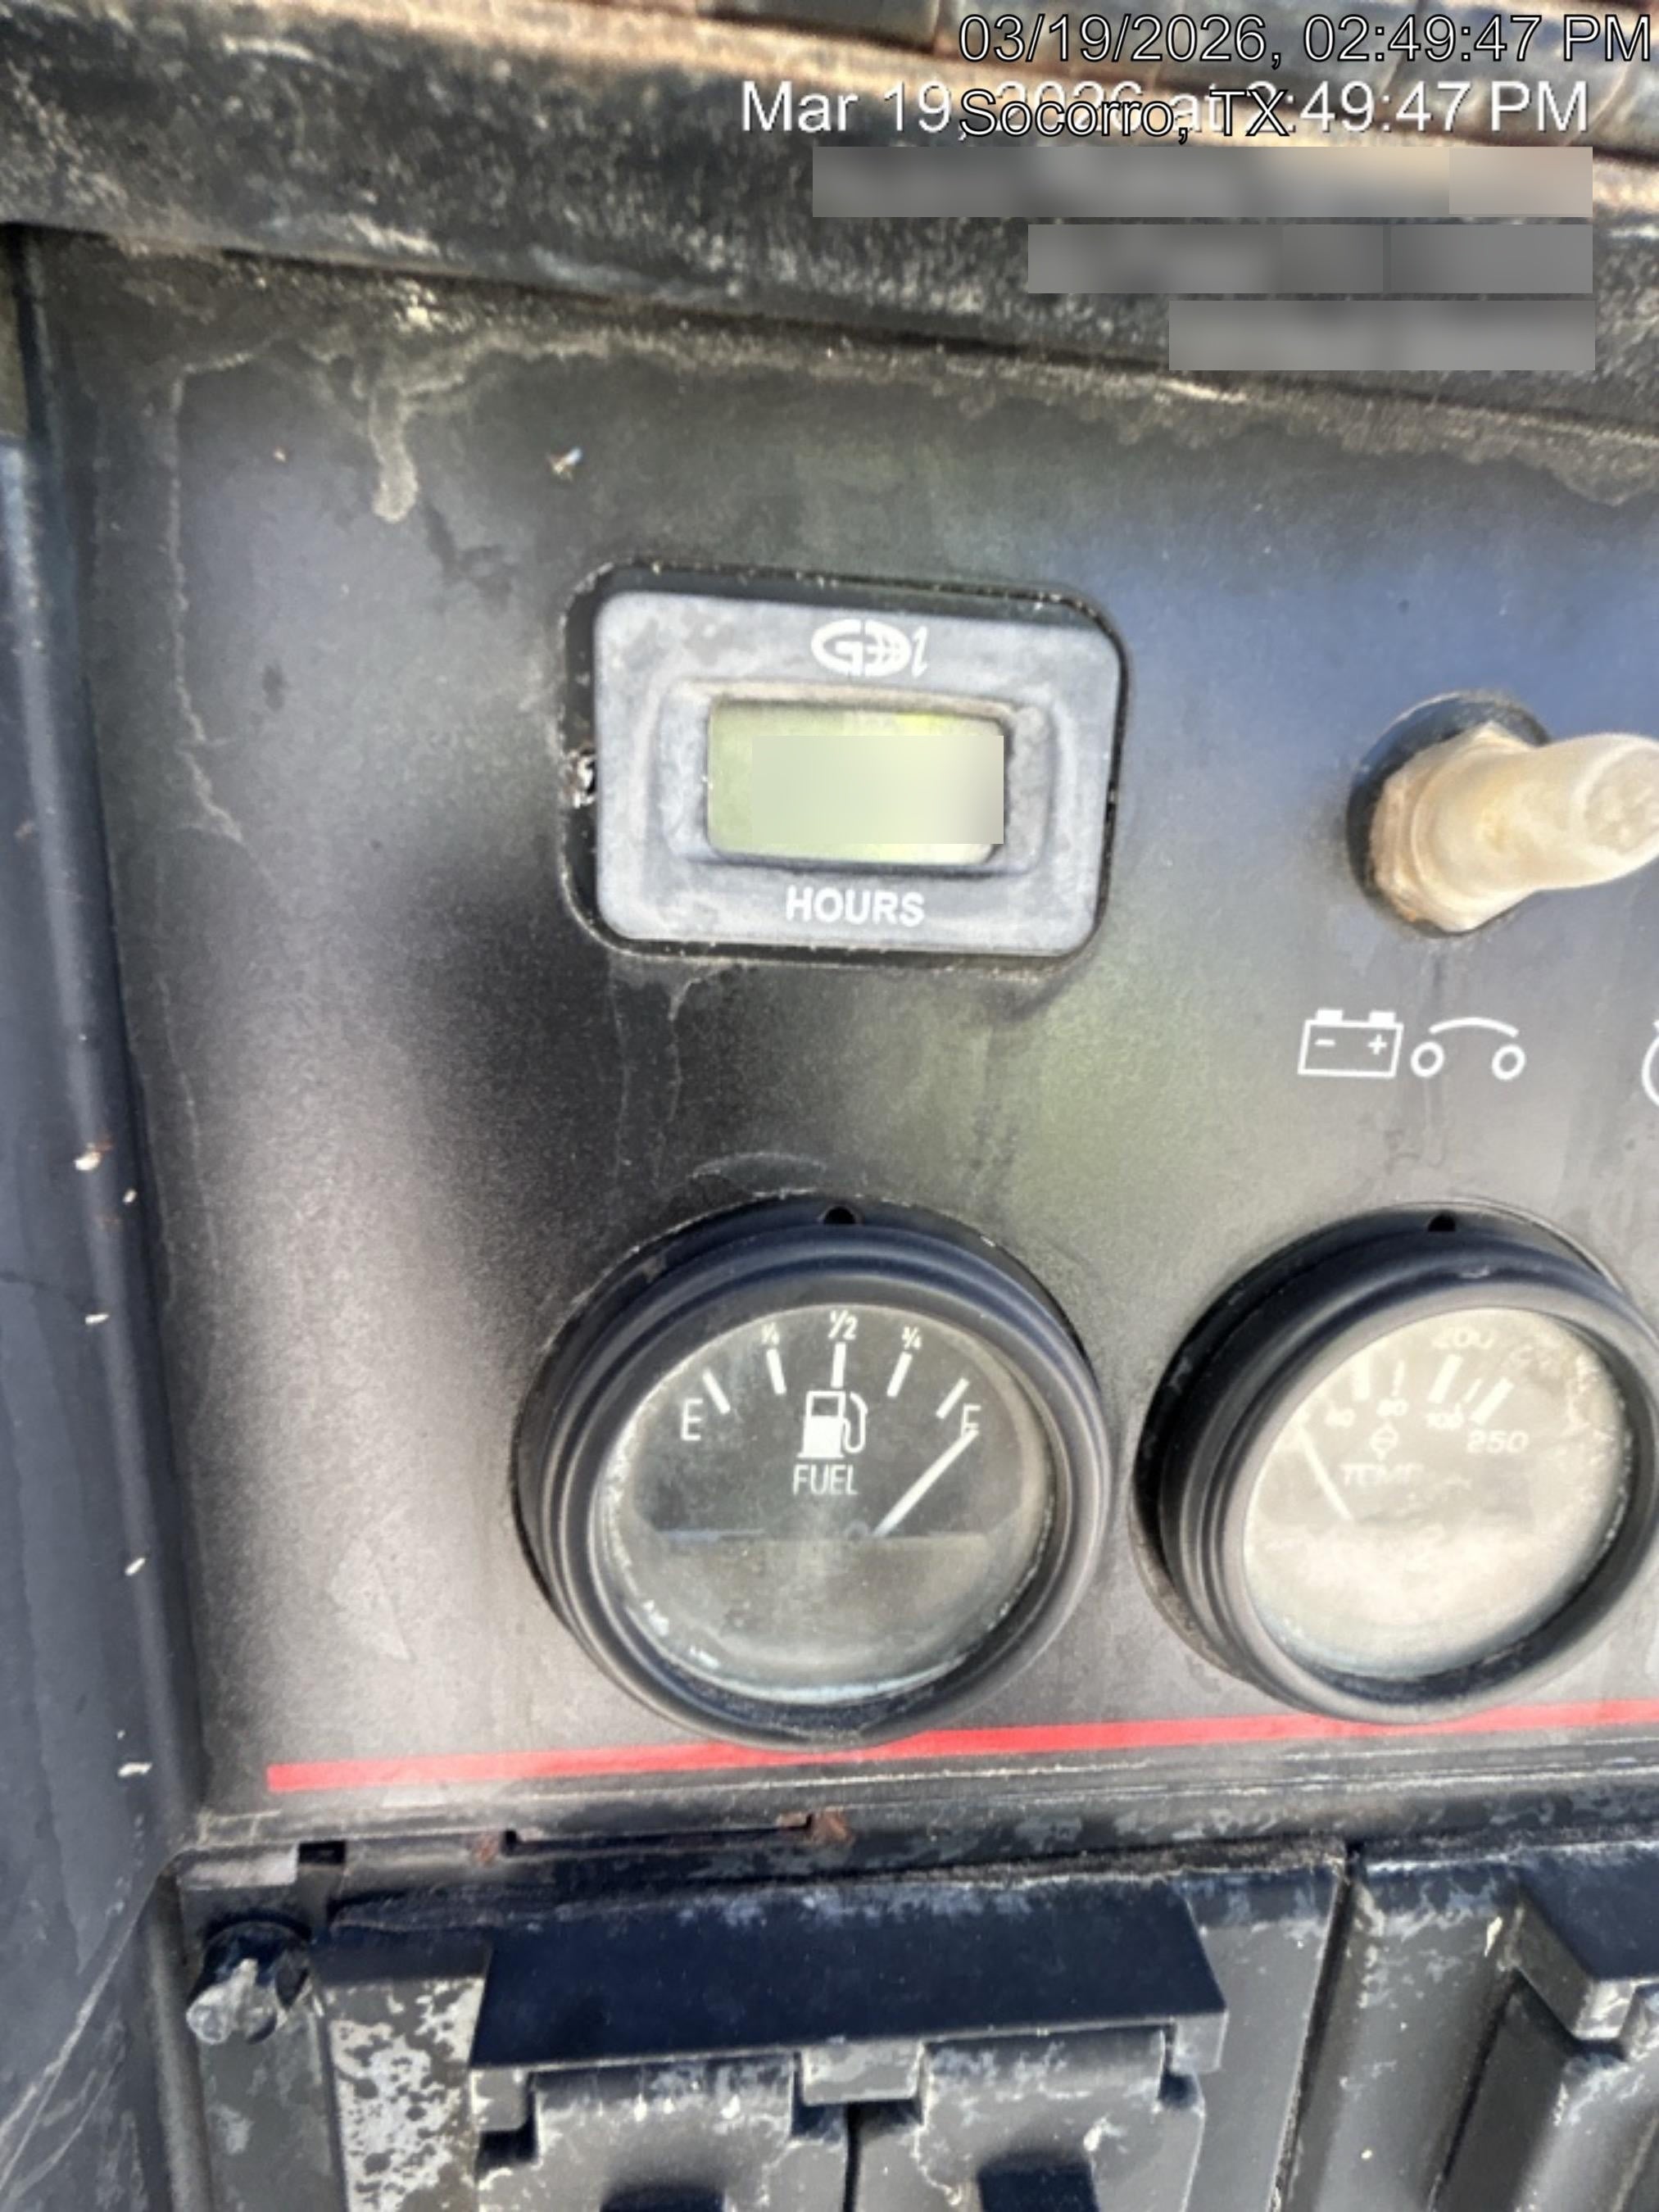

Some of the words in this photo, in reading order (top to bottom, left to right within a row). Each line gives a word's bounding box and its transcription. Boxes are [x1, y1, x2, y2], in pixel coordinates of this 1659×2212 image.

[785, 886, 925, 927] HOURS
[827, 1309, 858, 1340] 1/2
[681, 1398, 703, 1441] E
[960, 1403, 981, 1438] F
[1466, 1430, 1530, 1454] 250
[792, 1463, 858, 1495] FUEL
